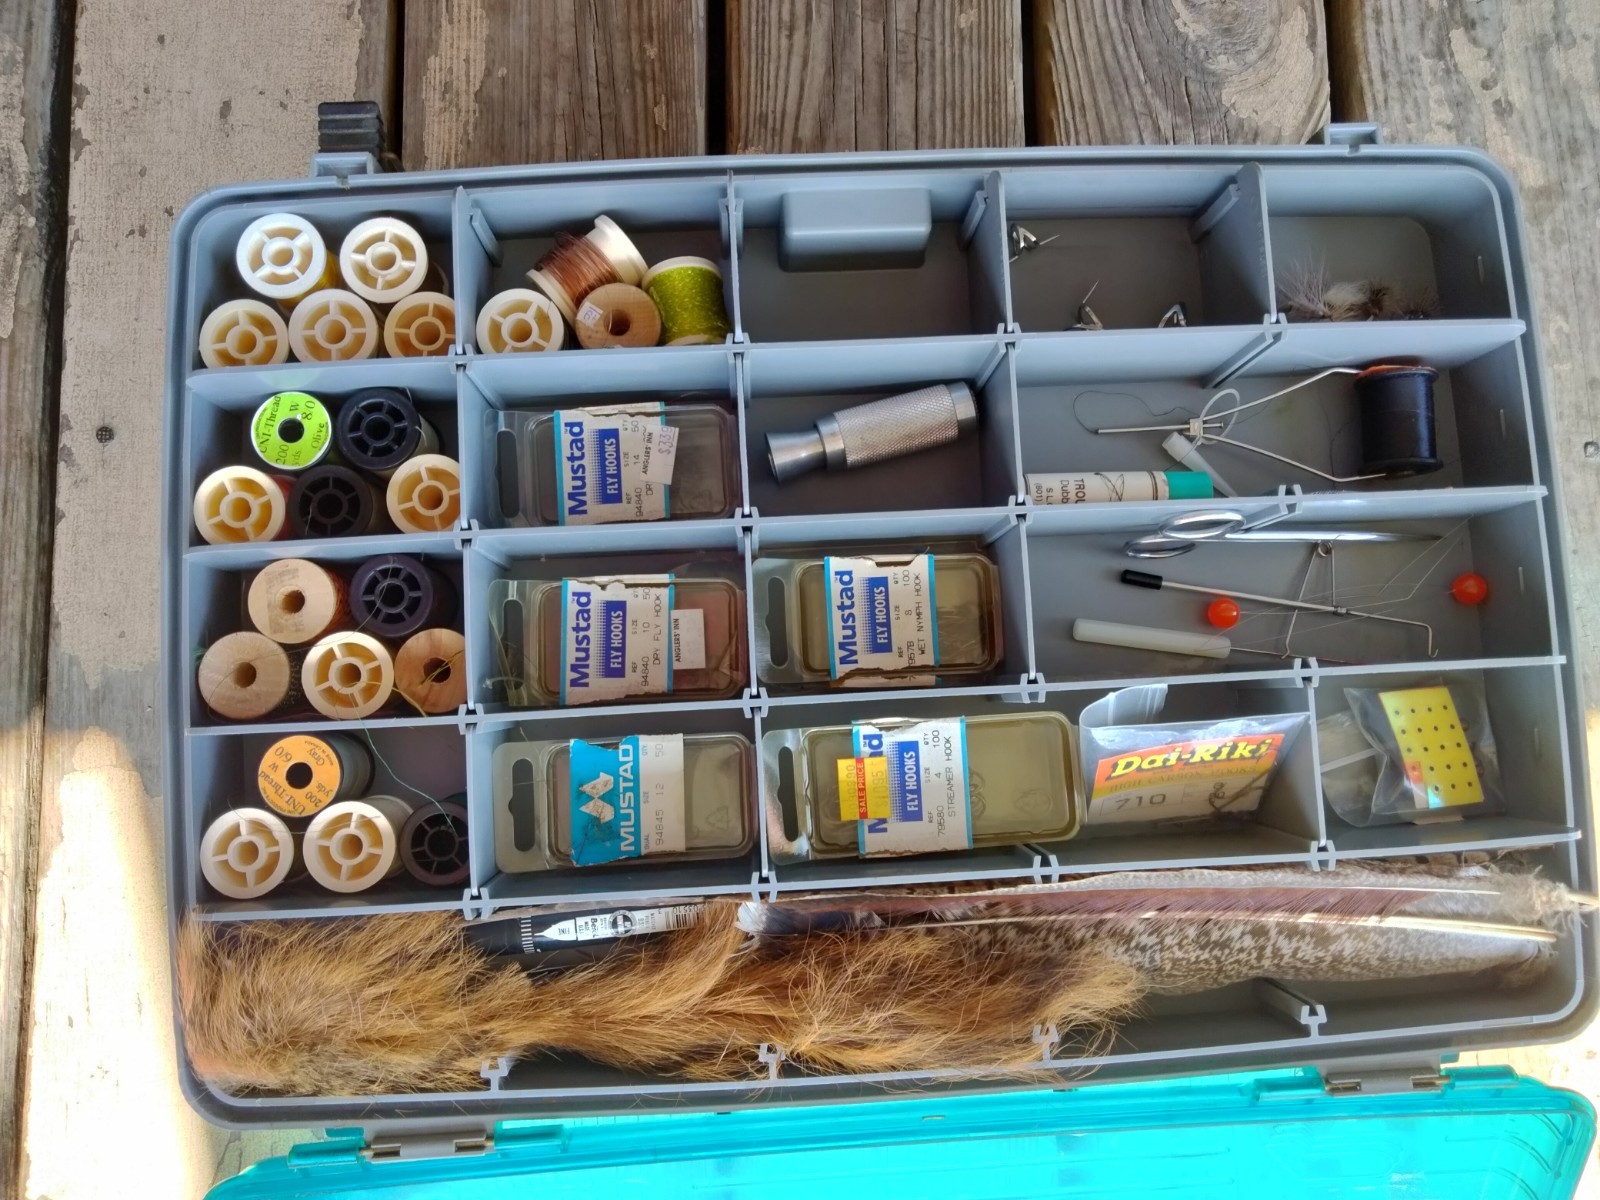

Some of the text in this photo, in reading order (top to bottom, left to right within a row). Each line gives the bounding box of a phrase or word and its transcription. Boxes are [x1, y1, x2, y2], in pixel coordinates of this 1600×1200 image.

[258, 396, 281, 454] UNI-Thread
[290, 401, 299, 412] W
[302, 400, 316, 420] 8/0
[276, 444, 289, 465] 200
[311, 423, 325, 449] Olive
[564, 421, 588, 515] Mustad
[605, 438, 618, 494] FLY HOOKS
[631, 421, 644, 517] 94840 14 50
[645, 481, 653, 495] DR
[654, 593, 662, 617] HOOK
[834, 570, 859, 665] Mustad
[874, 586, 888, 643] FLY HOOKS
[915, 602, 924, 632] NYMPH
[570, 591, 591, 688] Mustad
[610, 610, 623, 668] FLY HOOKS
[641, 588, 651, 687] 94840 10 50
[917, 637, 926, 655] WET
[653, 648, 661, 665] DRY
[274, 746, 292, 763] 6/0
[307, 748, 325, 766] Gray
[932, 730, 940, 748] 100
[268, 762, 278, 773] W
[943, 736, 956, 817] STREAMER HOOK
[1106, 738, 1274, 781] Dai-Riki
[259, 770, 306, 815] UNI-Thread
[305, 791, 323, 807] 200
[619, 744, 635, 851] MUSTAD
[655, 743, 664, 846] 94845 12 50
[857, 762, 867, 813] SALE PRICE
[904, 751, 919, 811] FLY HOOKS
[936, 805, 946, 836] 79580
[1115, 793, 1166, 811] 710
